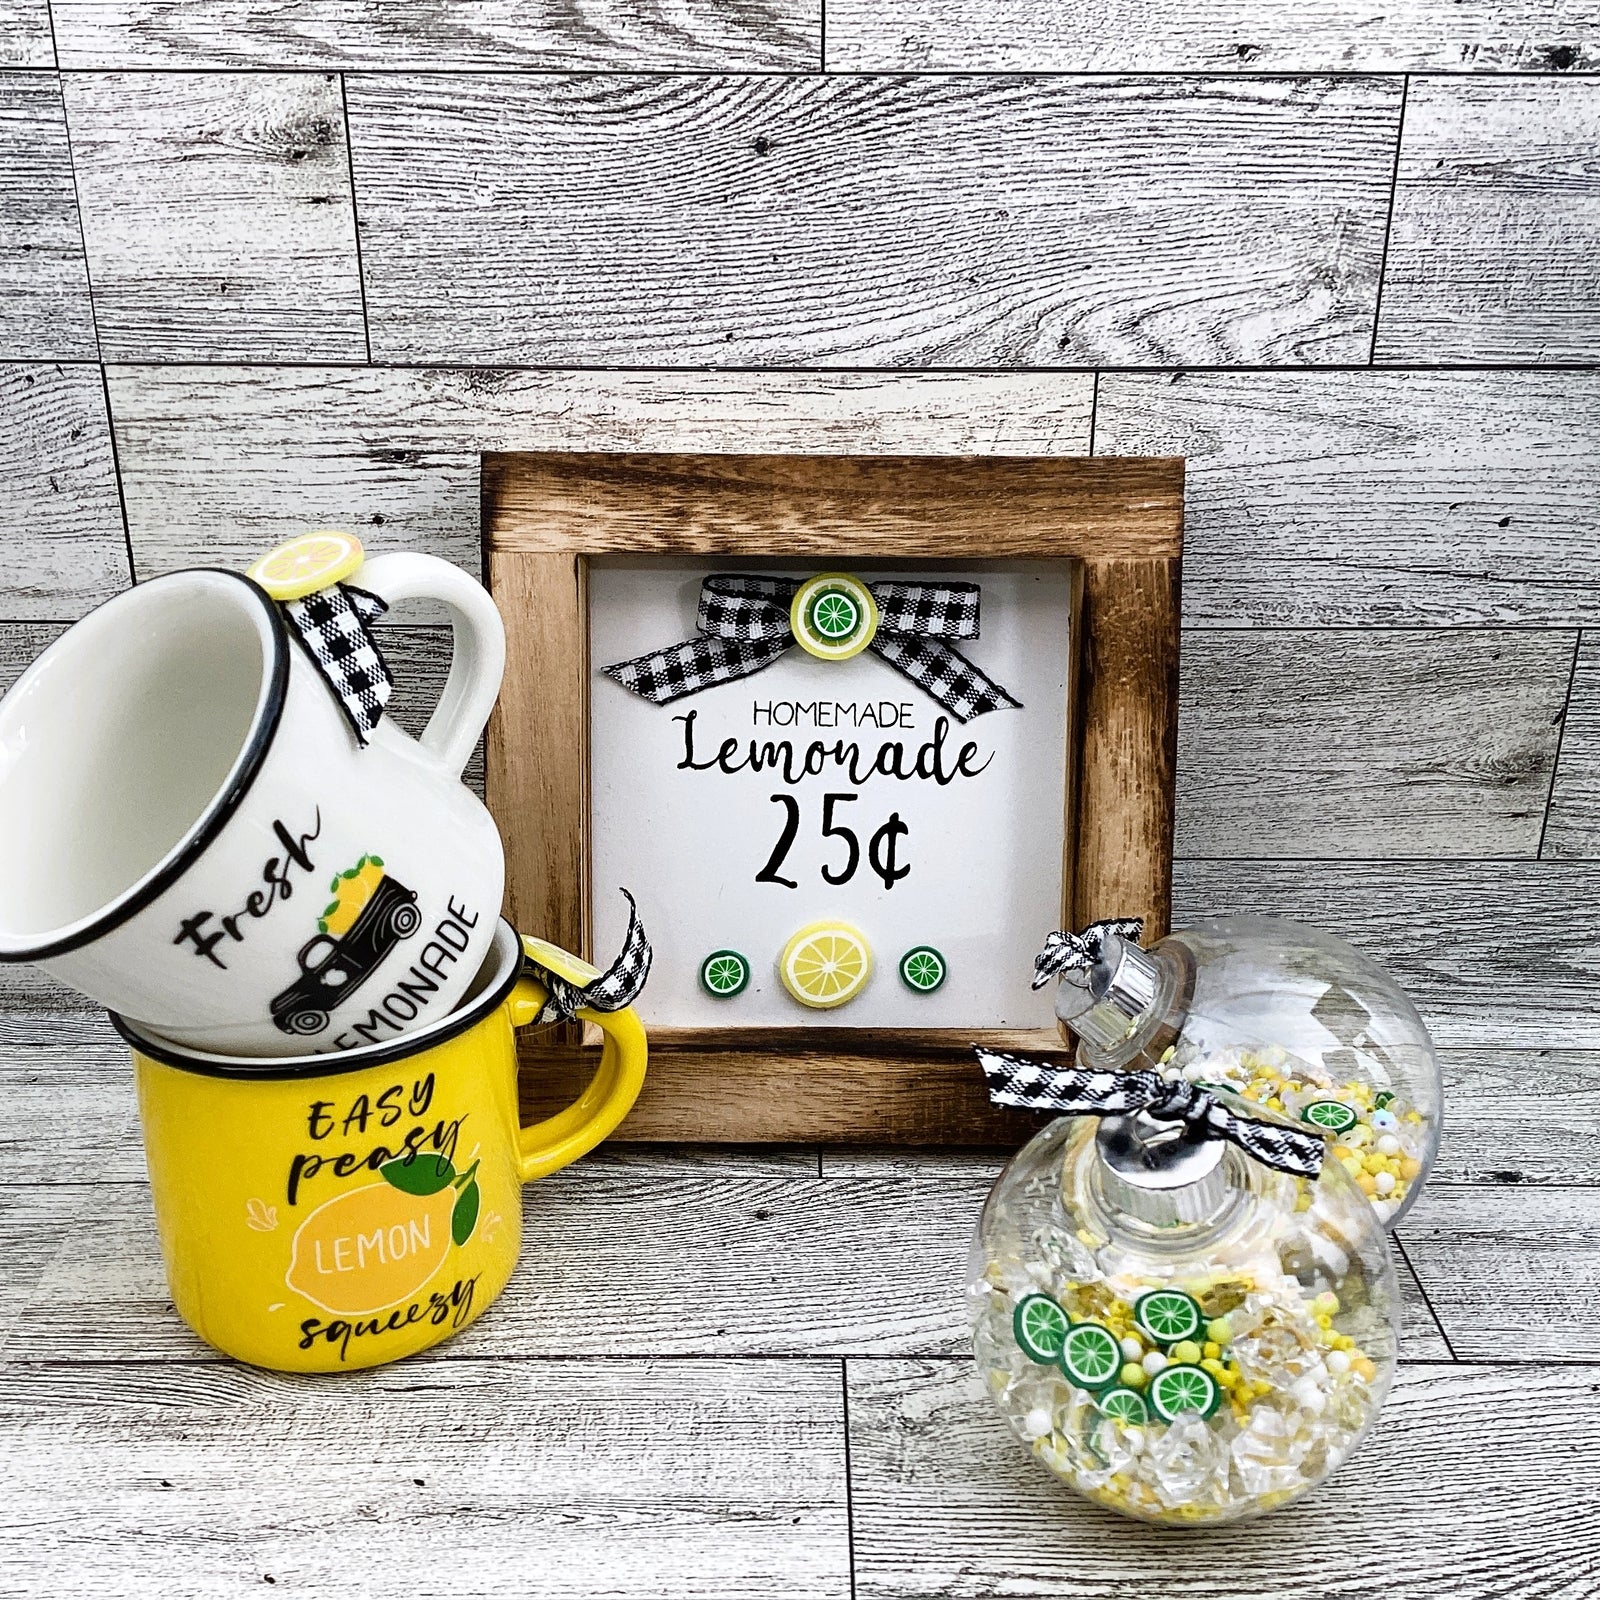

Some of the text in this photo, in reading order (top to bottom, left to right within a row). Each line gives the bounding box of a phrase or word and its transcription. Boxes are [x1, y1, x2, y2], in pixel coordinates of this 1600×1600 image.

[671, 709, 996, 786] Lemonade
[753, 700, 915, 729] HOMEMADE
[173, 804, 321, 970] Fresh
[755, 793, 911, 890] 25¢
[315, 894, 480, 1055] EMONADE
[307, 1072, 435, 1140] EASY
[286, 1113, 470, 1206] peasy
[315, 1213, 431, 1275] LEMON
[298, 1271, 484, 1362] squeezy
